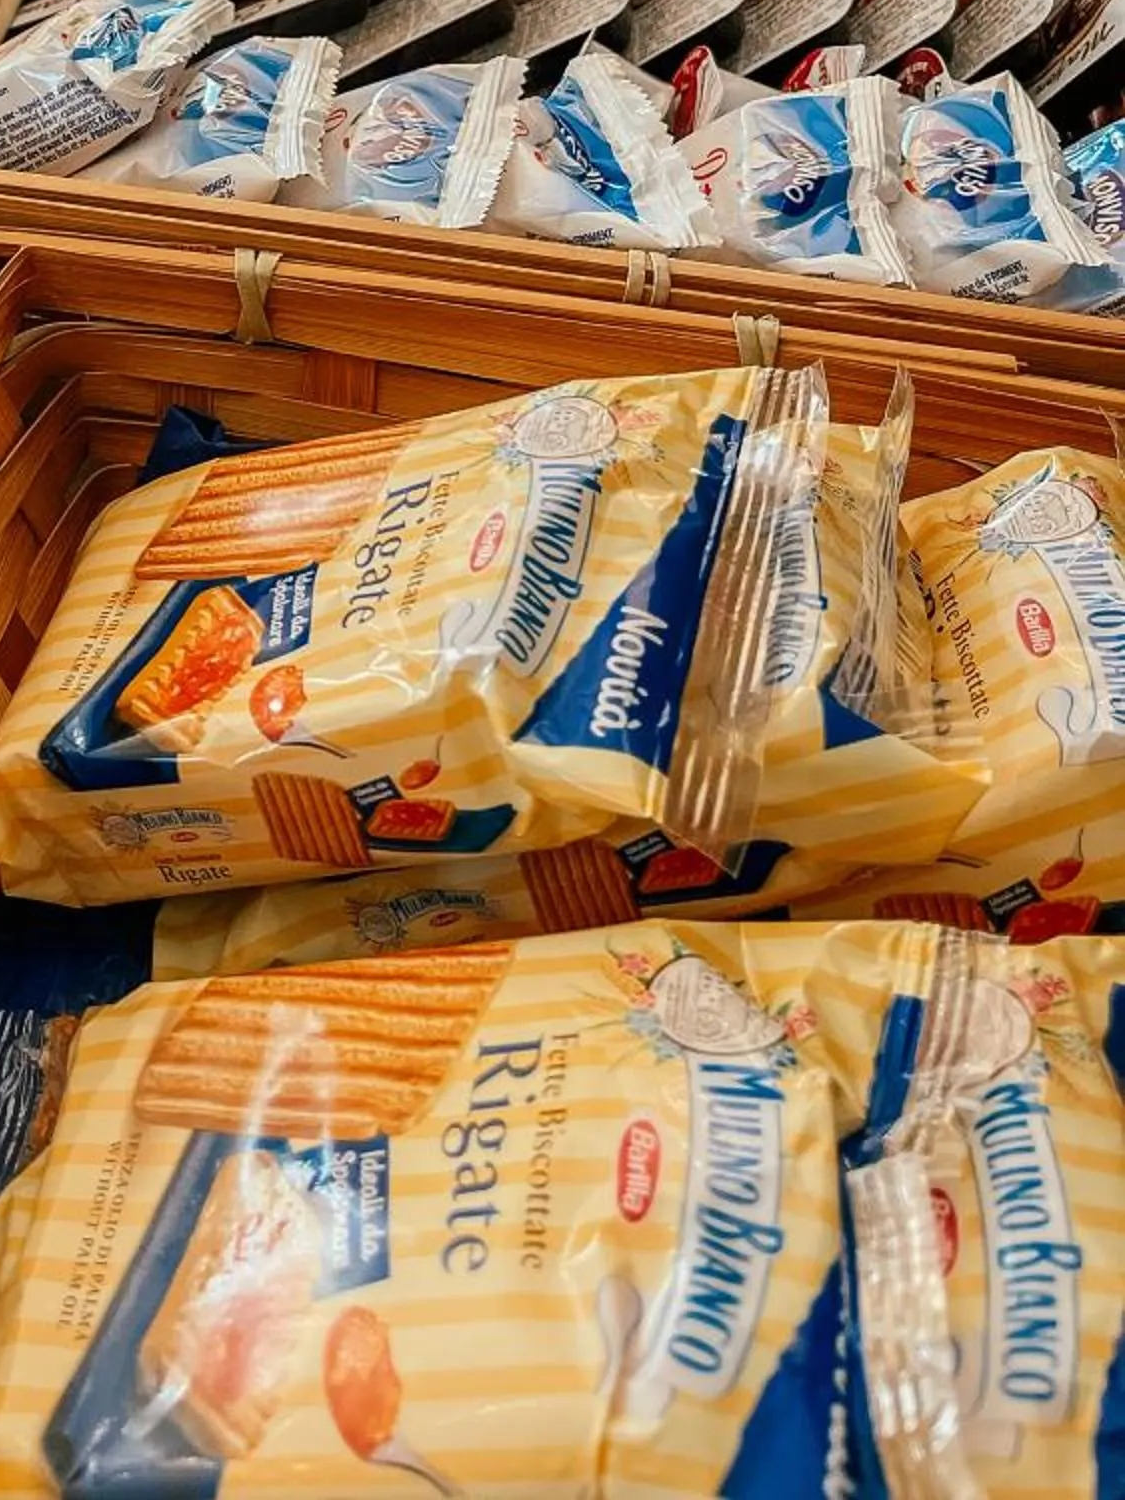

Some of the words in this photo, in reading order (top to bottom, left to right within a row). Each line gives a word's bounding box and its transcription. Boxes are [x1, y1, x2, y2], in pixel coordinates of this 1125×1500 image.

[429, 470, 460, 519] Fette
[531, 462, 603, 565] MULINO
[342, 475, 433, 629] Rigate
[397, 521, 448, 617] Biscottate
[495, 553, 583, 664] BIANCO
[935, 572, 959, 624] Fette
[950, 619, 991, 720] Biscottate
[1019, 603, 1052, 653] Barilla
[589, 605, 669, 738] Novità
[157, 864, 233, 886] Rigate
[539, 1032, 580, 1097] Fette
[116, 1131, 143, 1189] SENZA
[439, 1037, 545, 1277] Rigate
[620, 1124, 655, 1217] Barilla
[698, 1062, 785, 1206] MULINO
[974, 1082, 1051, 1234] MULINO
[85, 1139, 123, 1232] WITHOUT
[101, 1193, 125, 1241] OLIO
[359, 1149, 387, 1216] Ideali
[518, 1105, 569, 1271] Biscottate
[68, 1236, 96, 1290] PALM
[94, 1244, 113, 1267] DI
[359, 1222, 386, 1264] da
[667, 1203, 786, 1375] BIANCO
[74, 1271, 106, 1343] PALMA
[996, 1241, 1084, 1404] BIANCO
